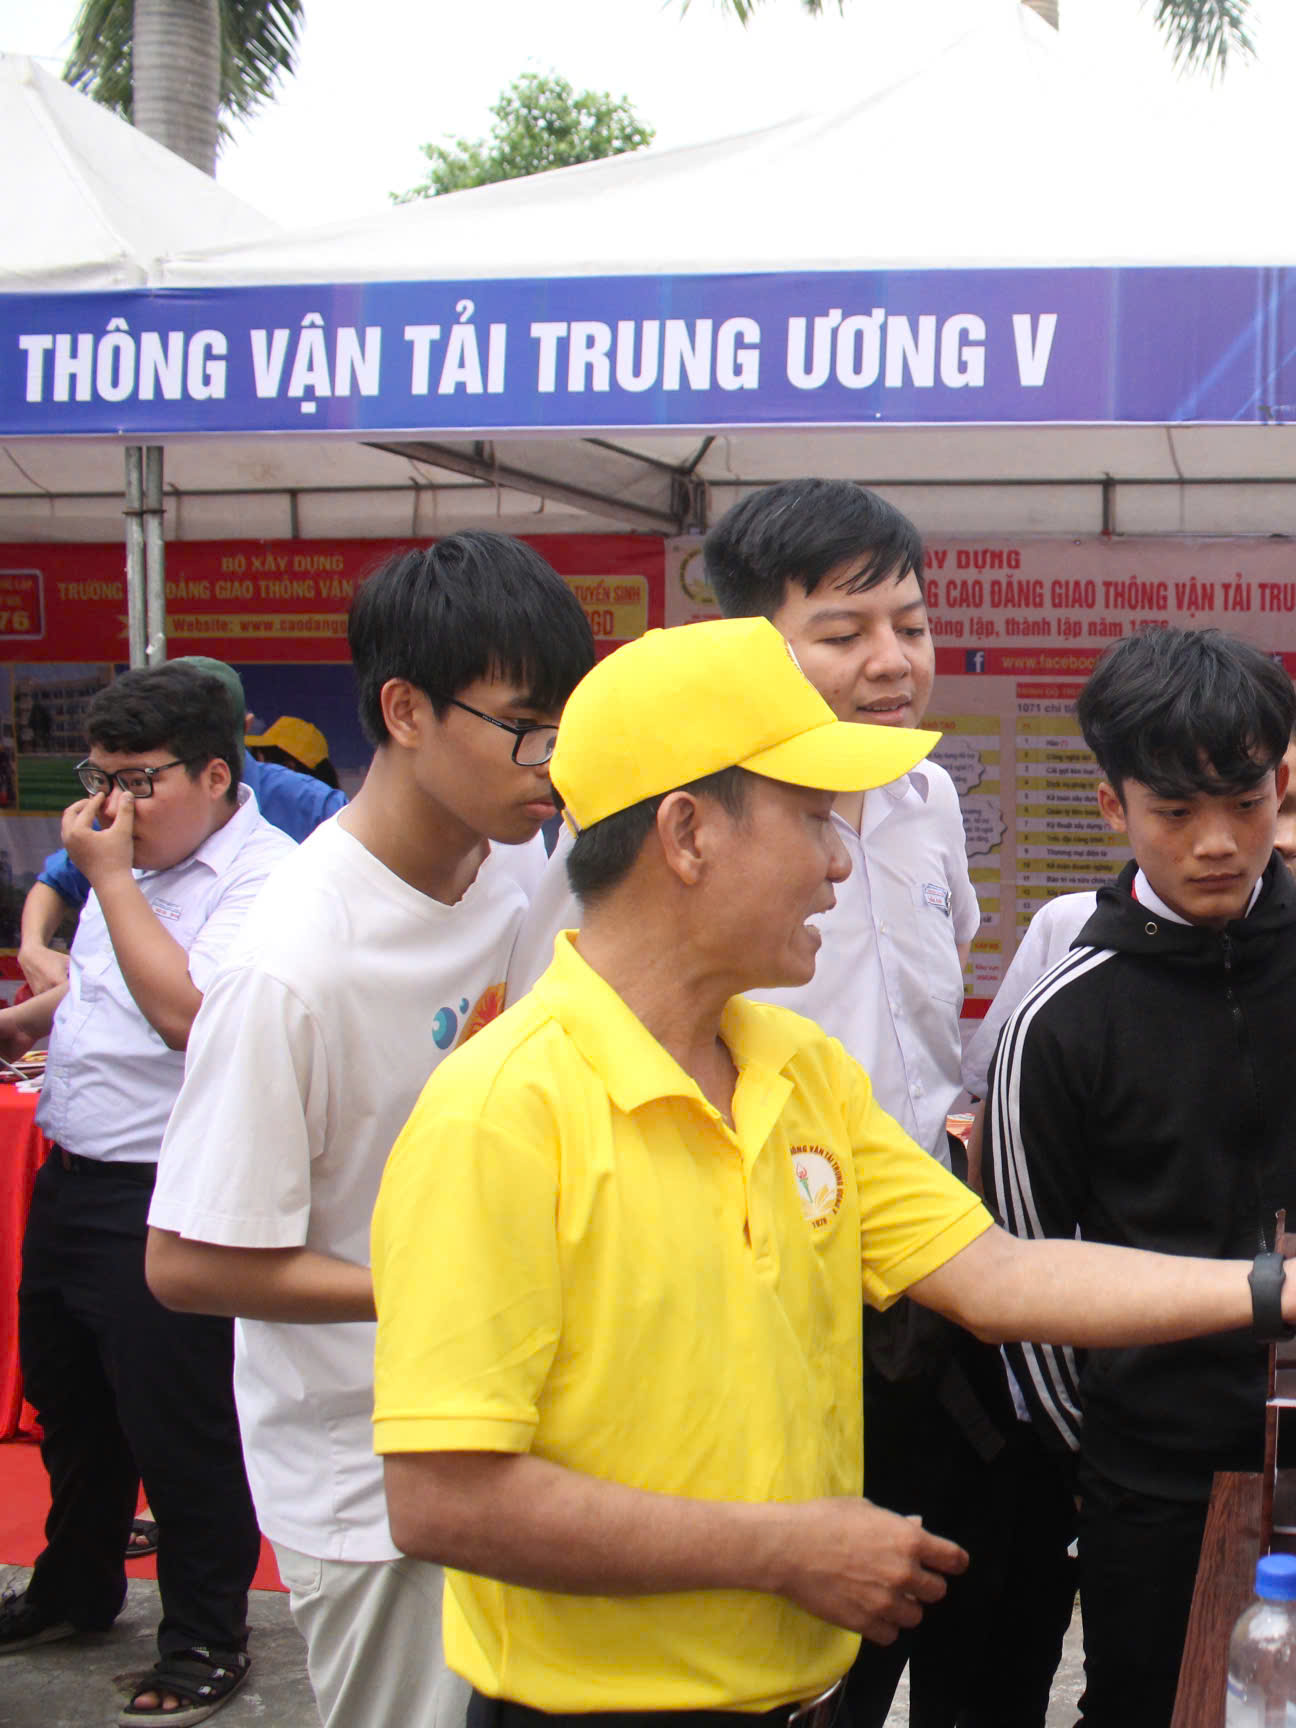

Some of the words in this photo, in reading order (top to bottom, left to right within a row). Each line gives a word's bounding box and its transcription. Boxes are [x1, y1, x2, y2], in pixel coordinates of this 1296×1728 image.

[18, 317, 228, 402] THÔNG
[250, 311, 381, 414] VẬN
[403, 298, 507, 396] TẢI
[529, 316, 761, 393] TRUNG
[785, 307, 986, 390] ƯƠNG
[1012, 313, 1058, 387] V
[957, 547, 1021, 573] DỰNG
[946, 578, 984, 609] CAO
[1051, 579, 1096, 609] GIAO
[1103, 575, 1168, 610] THÔNG
[1175, 576, 1215, 618] VẬN
[1222, 572, 1251, 612] TẢI
[587, 610, 614, 635] GD
[1005, 616, 1051, 637] thành
[1057, 617, 1082, 641] lập
